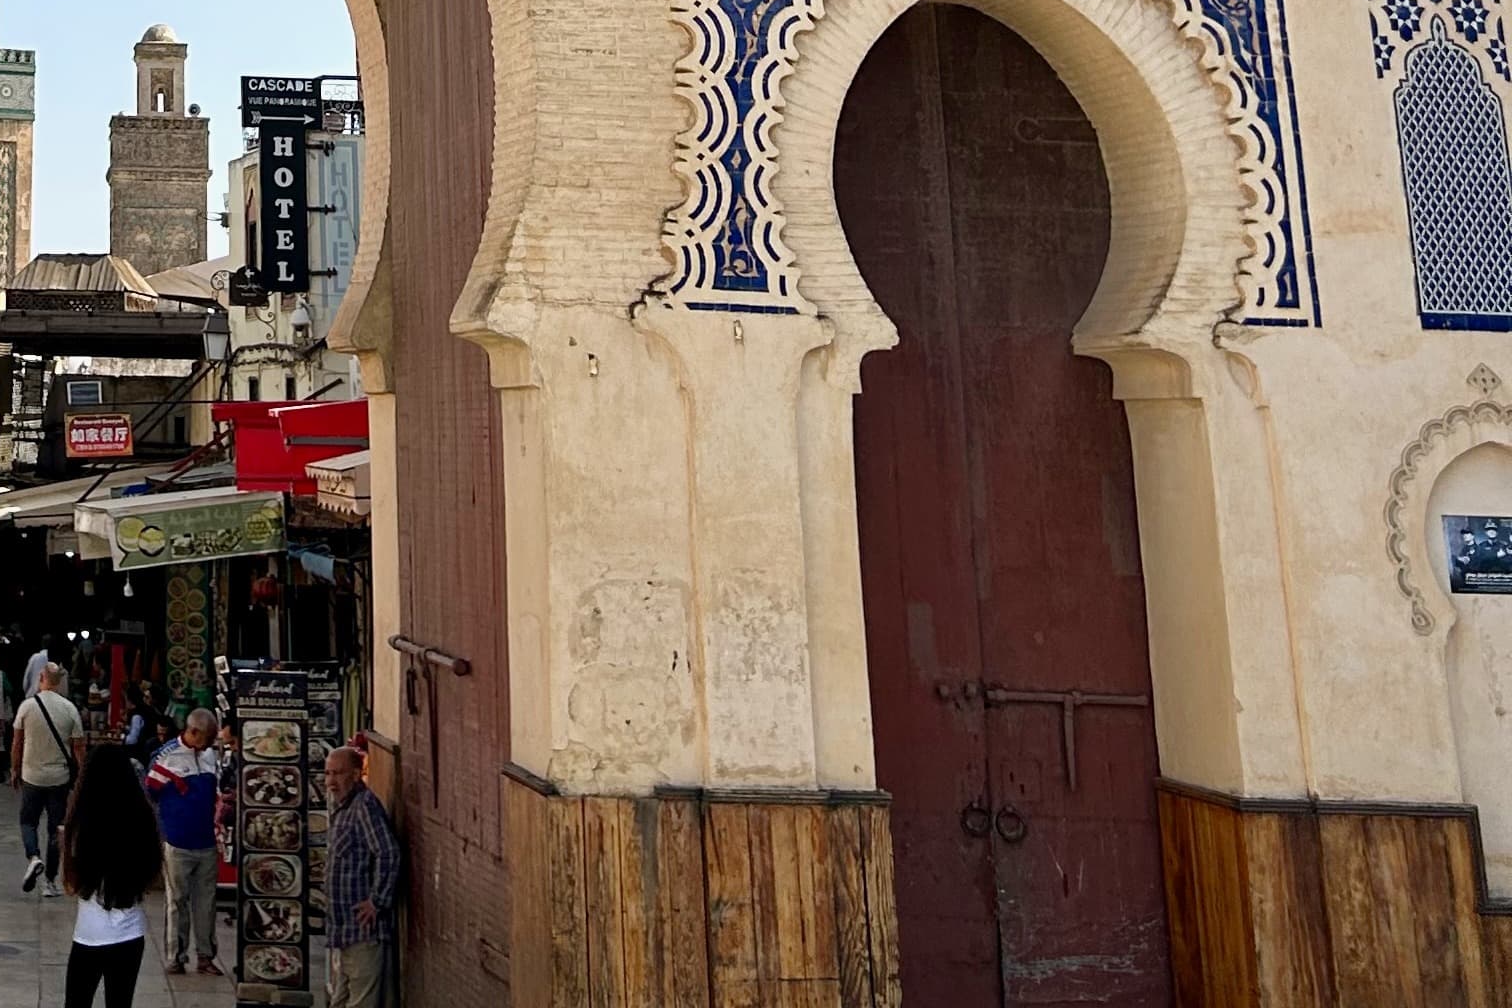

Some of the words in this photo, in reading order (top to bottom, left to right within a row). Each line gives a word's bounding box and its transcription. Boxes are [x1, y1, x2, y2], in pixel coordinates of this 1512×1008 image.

[248, 79, 314, 93] CASCADE
[248, 96, 264, 105] VUE
[272, 136, 295, 283] HOTEL
